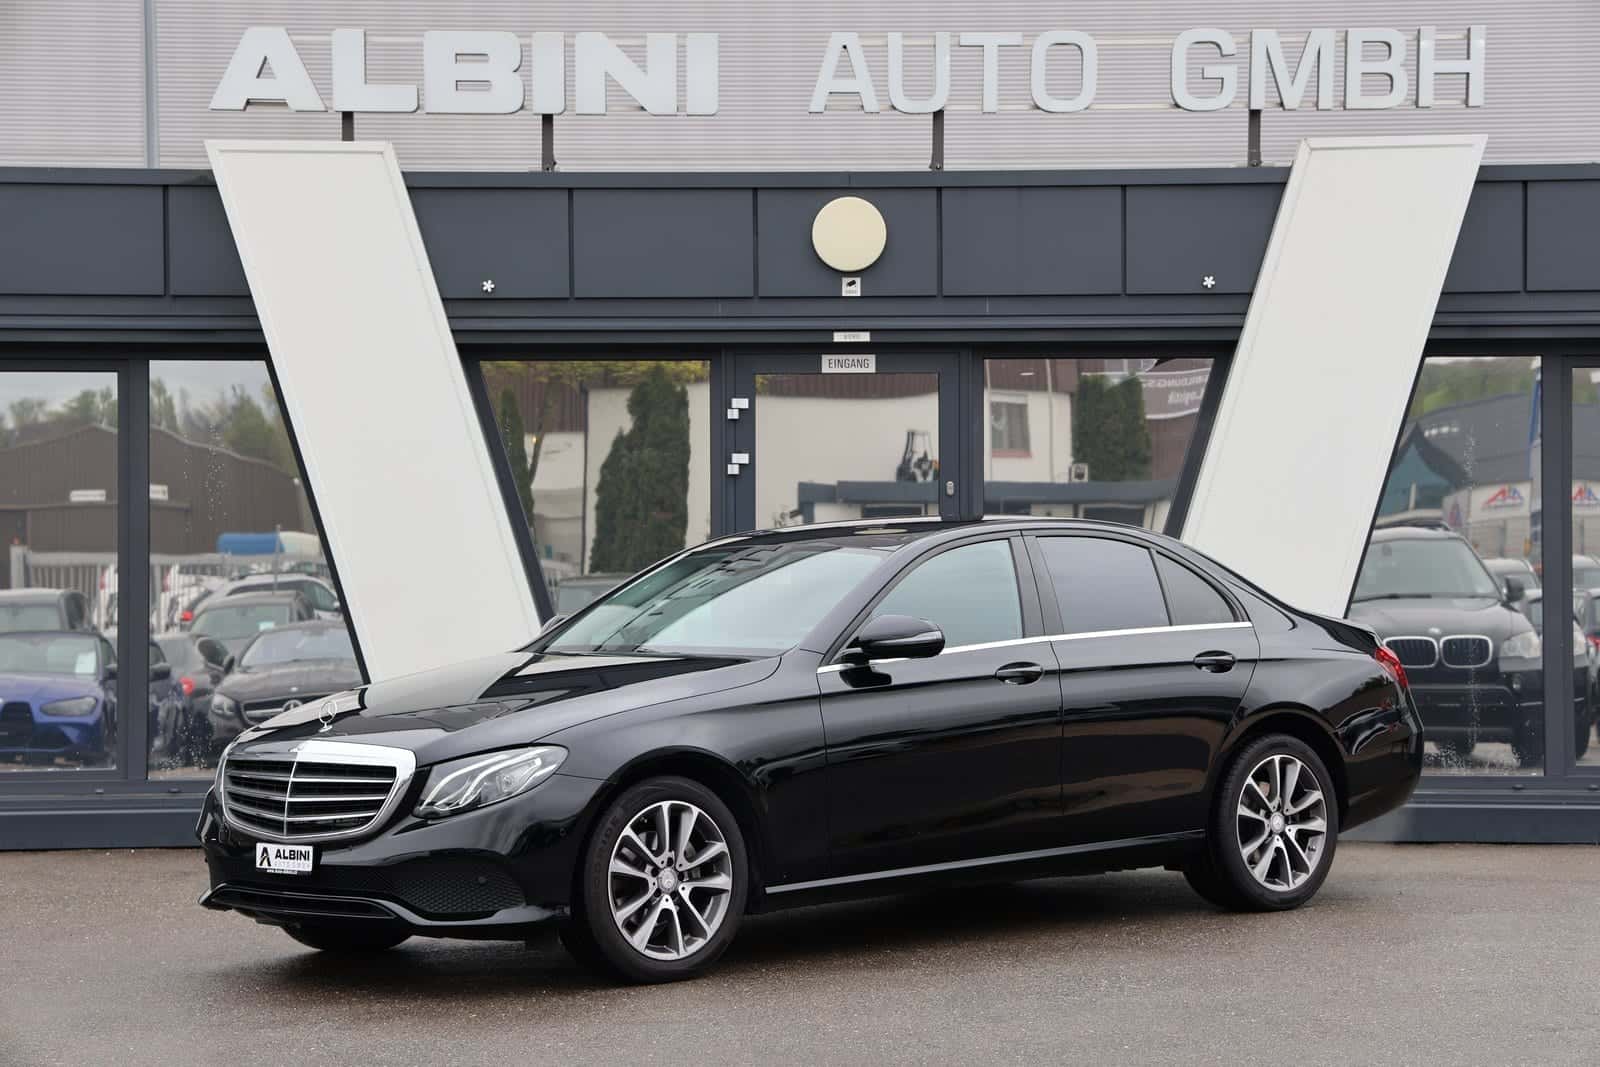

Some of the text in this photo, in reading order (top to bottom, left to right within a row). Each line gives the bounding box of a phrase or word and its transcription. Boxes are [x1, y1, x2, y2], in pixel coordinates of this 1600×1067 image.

[209, 25, 1487, 115] ALBINI AUTO GMBH
[828, 358, 870, 369] EINGANG
[274, 848, 310, 861] ALBINI
